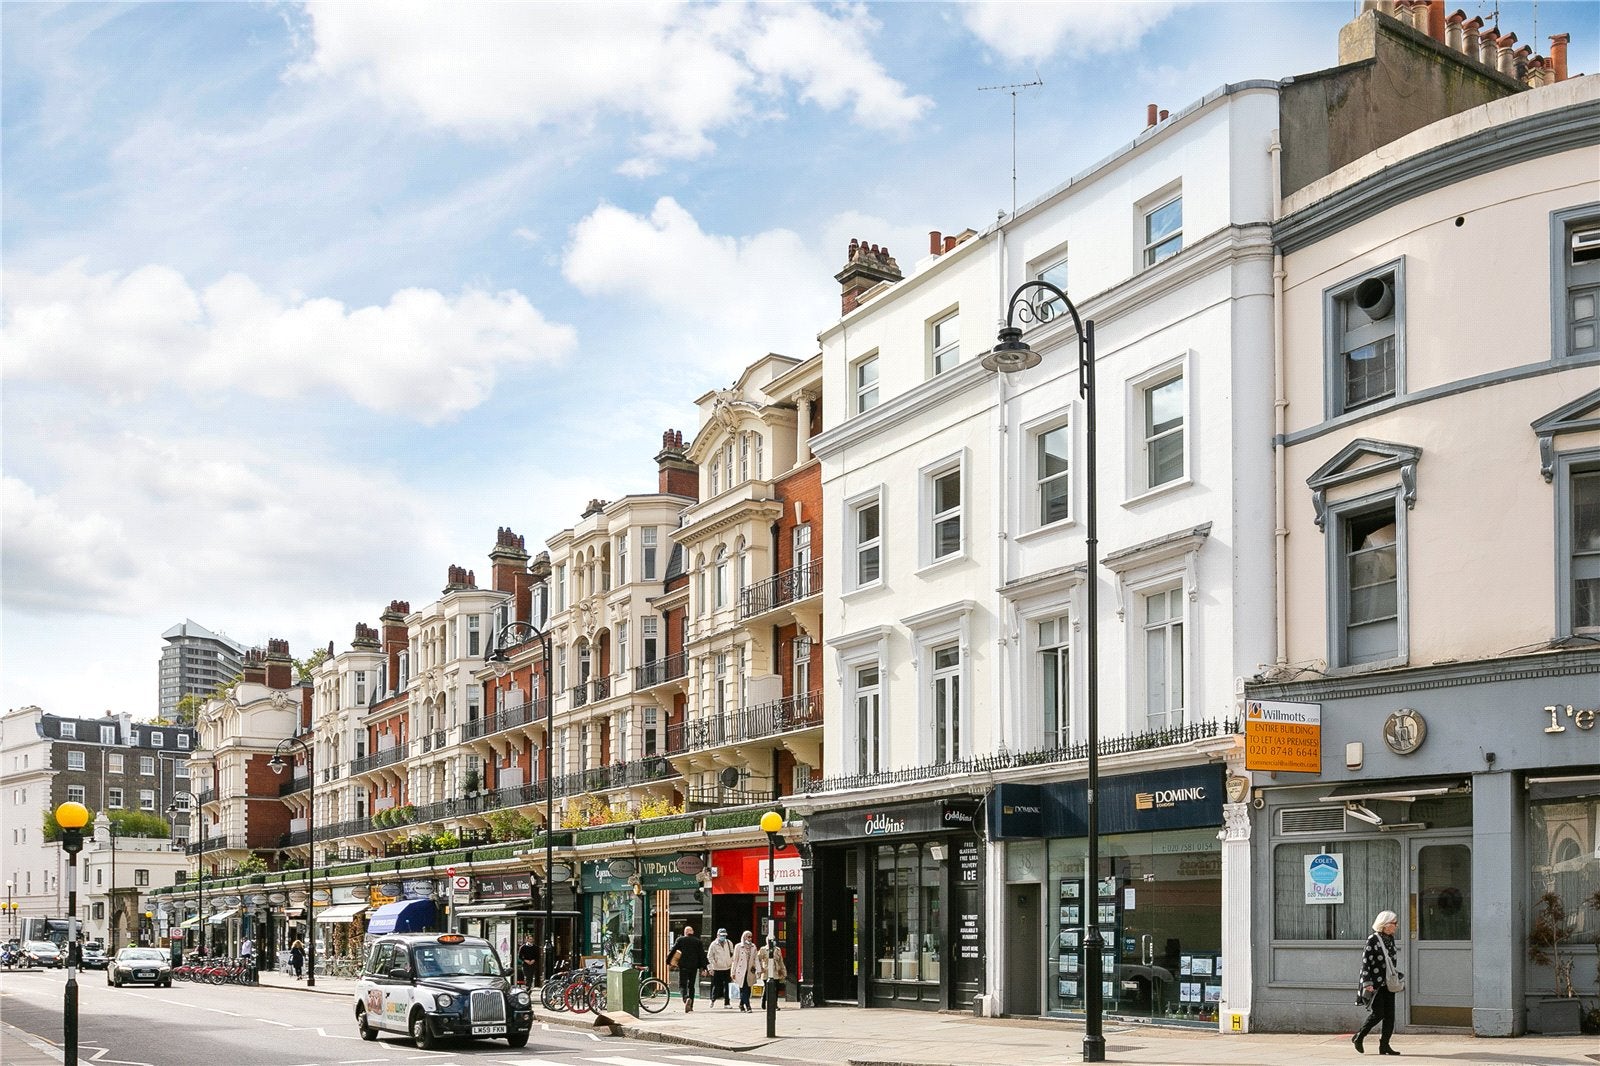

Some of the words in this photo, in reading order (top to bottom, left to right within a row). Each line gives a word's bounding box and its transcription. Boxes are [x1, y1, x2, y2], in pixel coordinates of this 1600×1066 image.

[1544, 704, 1600, 731] l'e
[1255, 724, 1279, 733] ENTIRE
[1281, 726, 1314, 735] BUILDING
[1250, 735, 1260, 744] TO
[1261, 736, 1272, 744] LET
[1249, 745, 1267, 755] 020
[1270, 747, 1293, 756] 8748
[1296, 748, 1318, 758] 6644
[1155, 787, 1206, 803] DOMINIC
[945, 810, 973, 822] Oddbins
[865, 813, 905, 835] Oddbins
[643, 863, 656, 875] VIP
[657, 862, 668, 876] Dry
[963, 870, 977, 880] ICE
[1312, 882, 1322, 892] To
[1232, 1015, 1240, 1028] H
